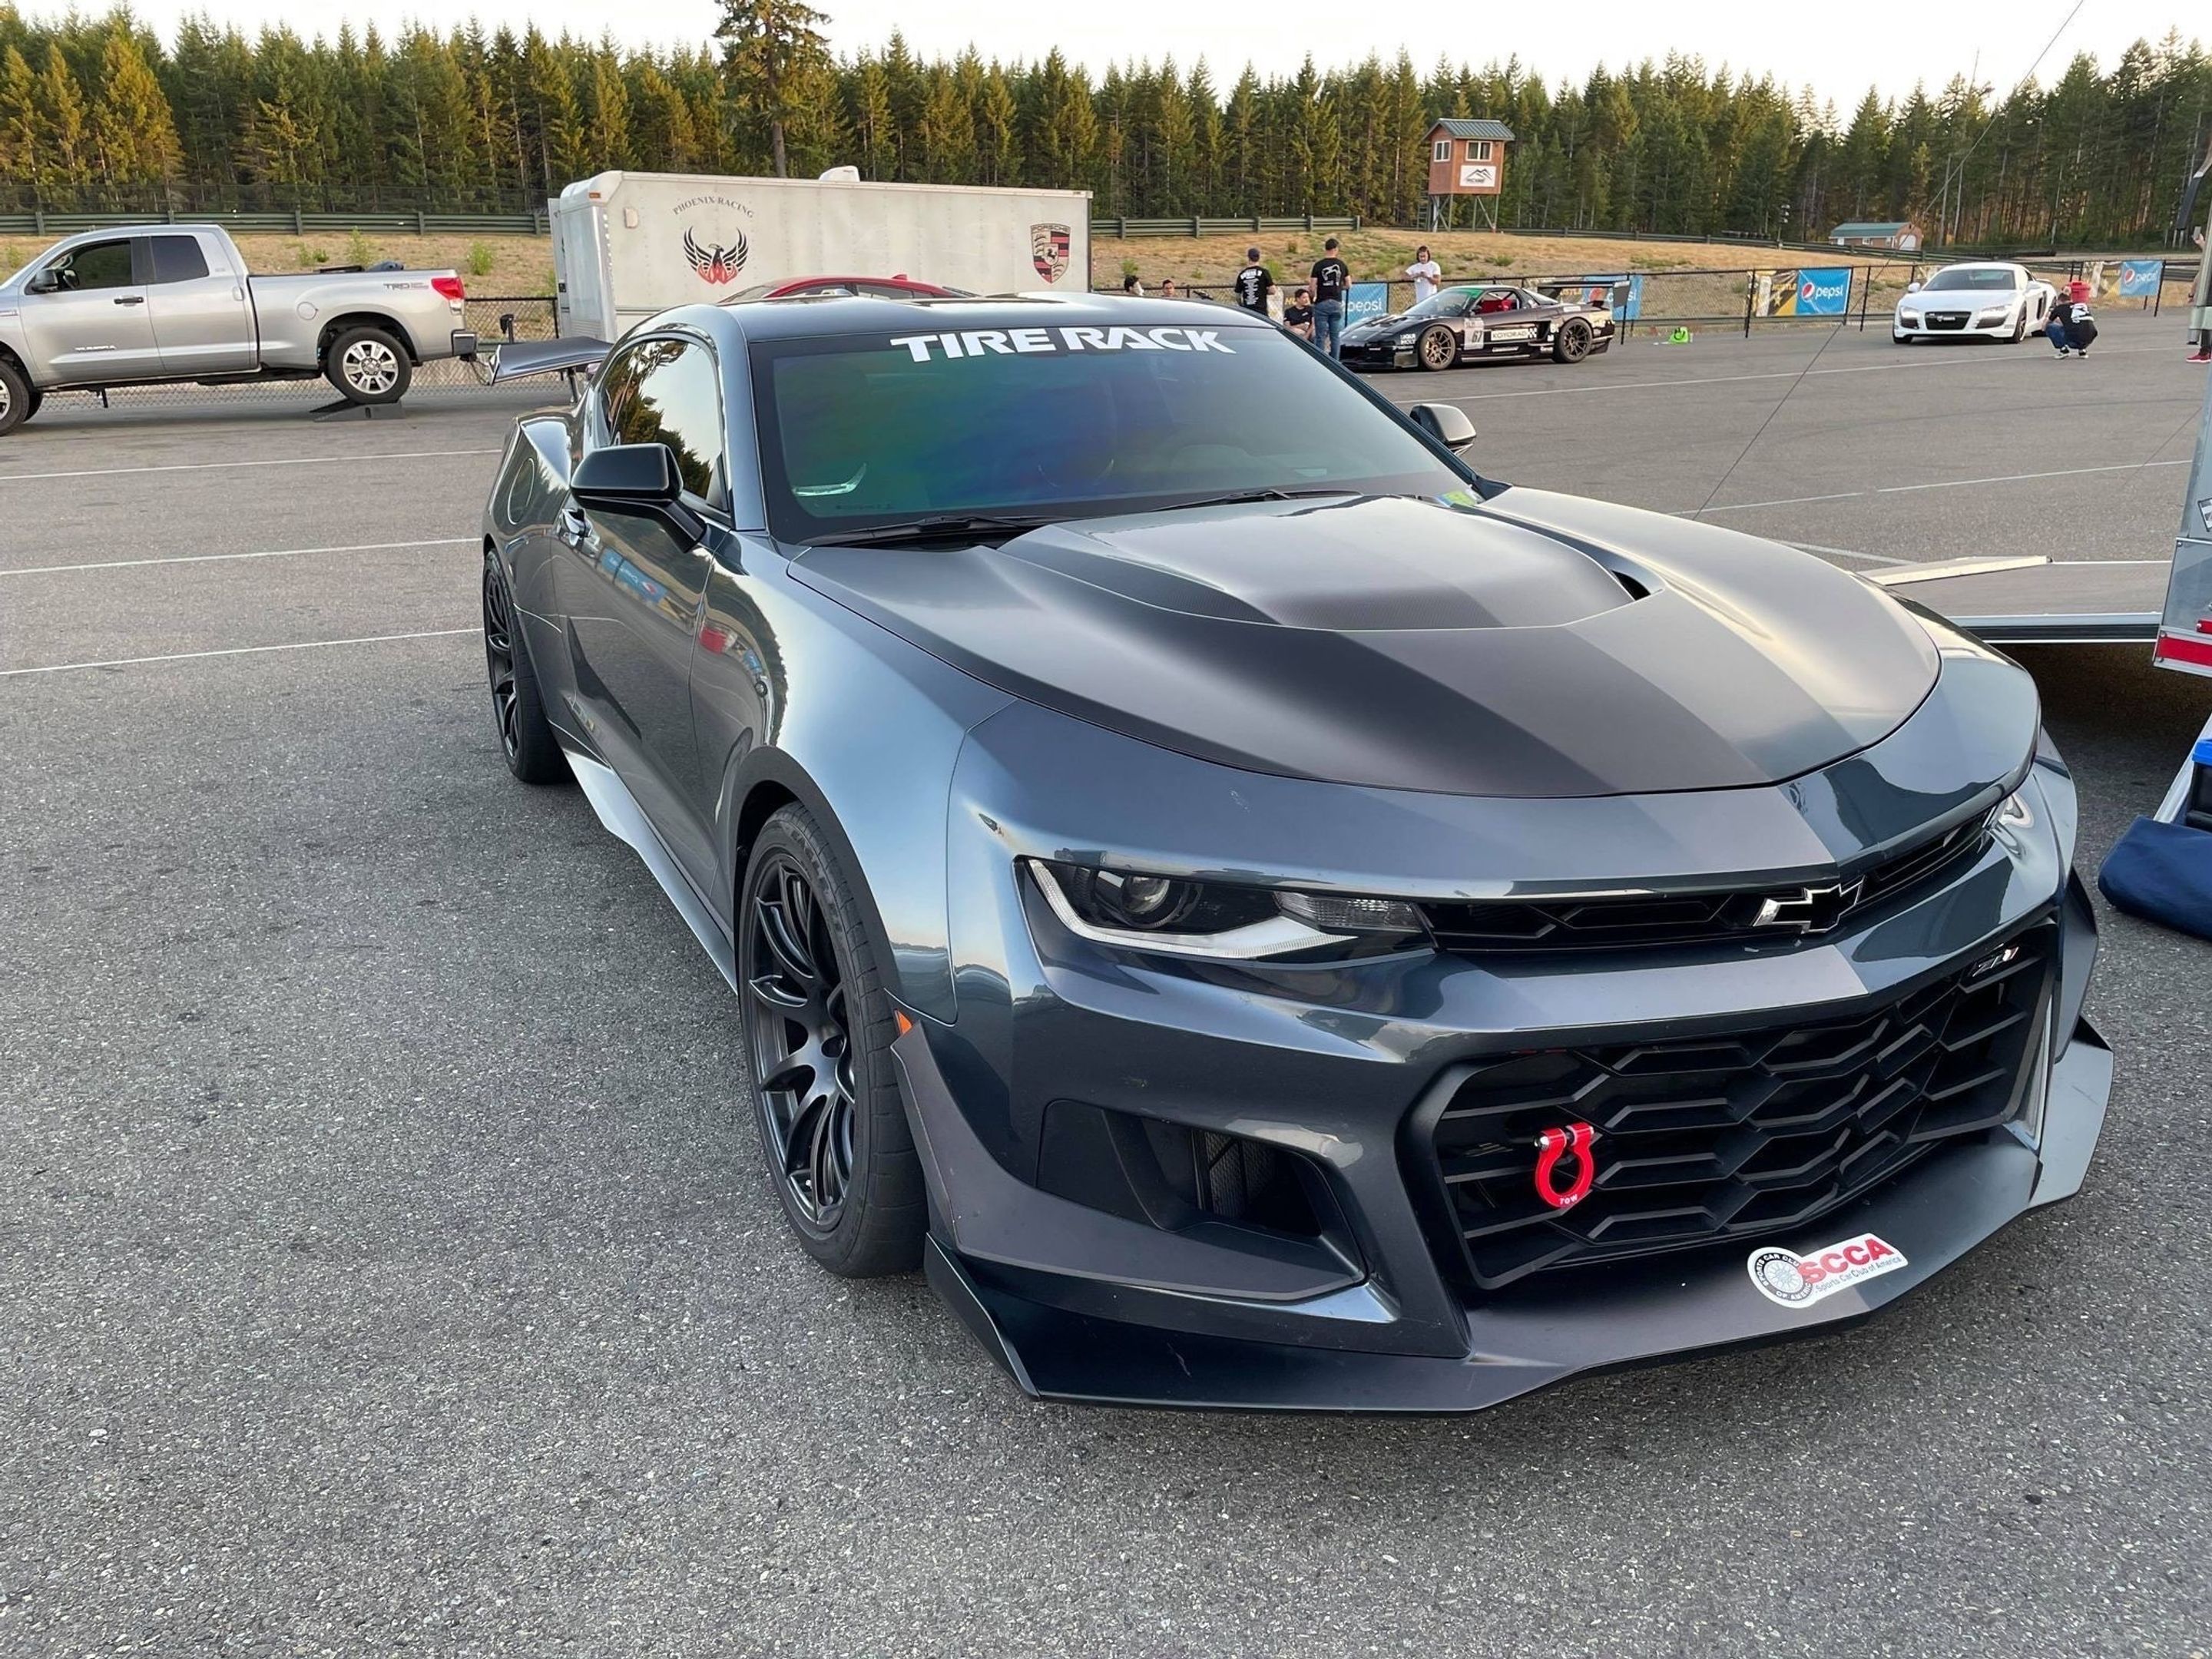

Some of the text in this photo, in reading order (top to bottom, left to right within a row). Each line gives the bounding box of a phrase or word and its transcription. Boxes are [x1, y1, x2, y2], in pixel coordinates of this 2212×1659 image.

[673, 196, 753, 218] PHOENIX RACING
[1815, 285, 1843, 300] pepsi
[1471, 330, 1483, 343] 67
[1492, 330, 1526, 339] KOYORAD
[890, 328, 1237, 363] TIRE RACK
[1560, 1194, 1578, 1204] TOW
[1782, 1256, 1800, 1267] CLU
[1797, 1238, 1895, 1283] SCCA
[1816, 1278, 1840, 1292] Sports
[1839, 1273, 1852, 1283] Car
[1851, 1267, 1869, 1278] Club
[1876, 1257, 1902, 1269] America
[1776, 1281, 1812, 1300] OF AMERIC
